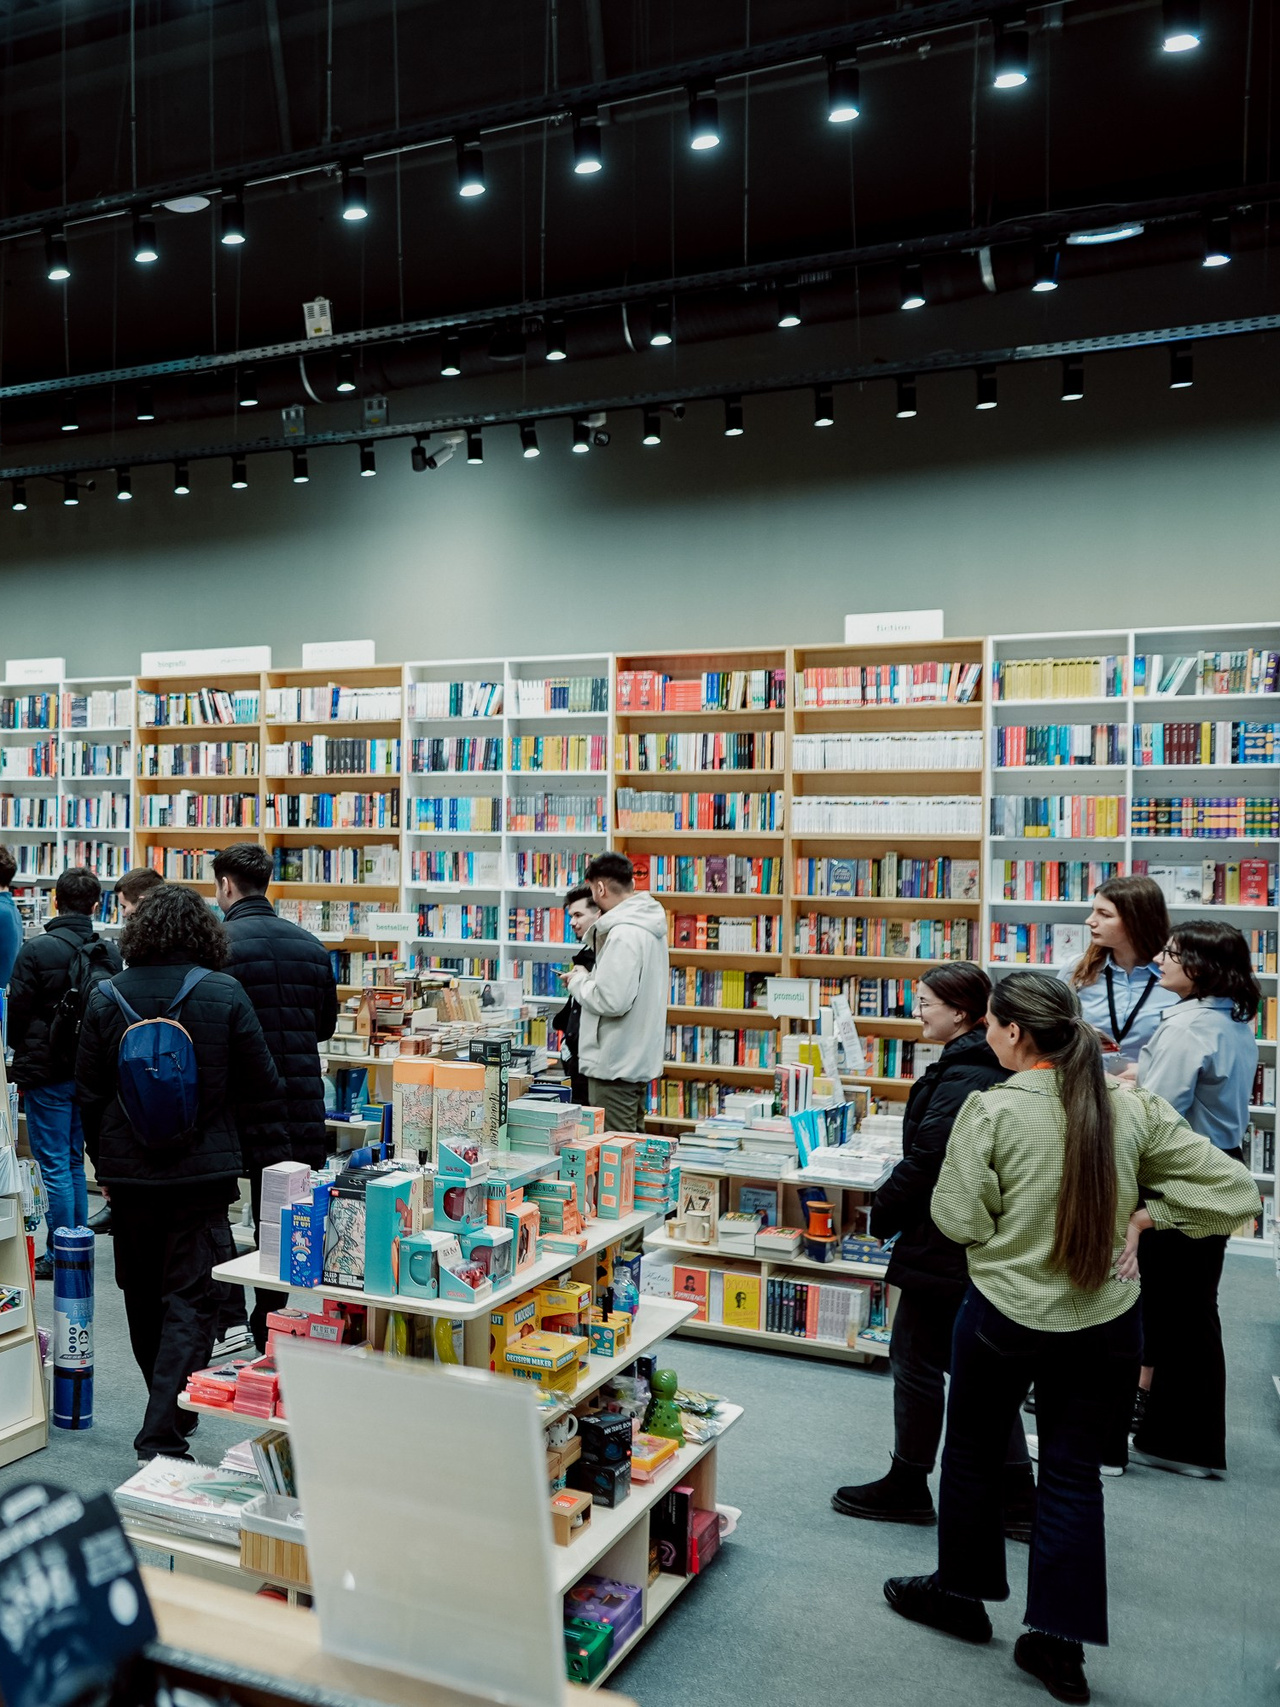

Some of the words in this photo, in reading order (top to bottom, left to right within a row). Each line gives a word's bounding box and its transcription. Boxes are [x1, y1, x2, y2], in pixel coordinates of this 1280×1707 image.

[773, 992, 805, 1002] promoții
[293, 1214, 311, 1222] SHAKE
[506, 1353, 532, 1364] DECISION
[531, 1358, 553, 1368] MAKER
